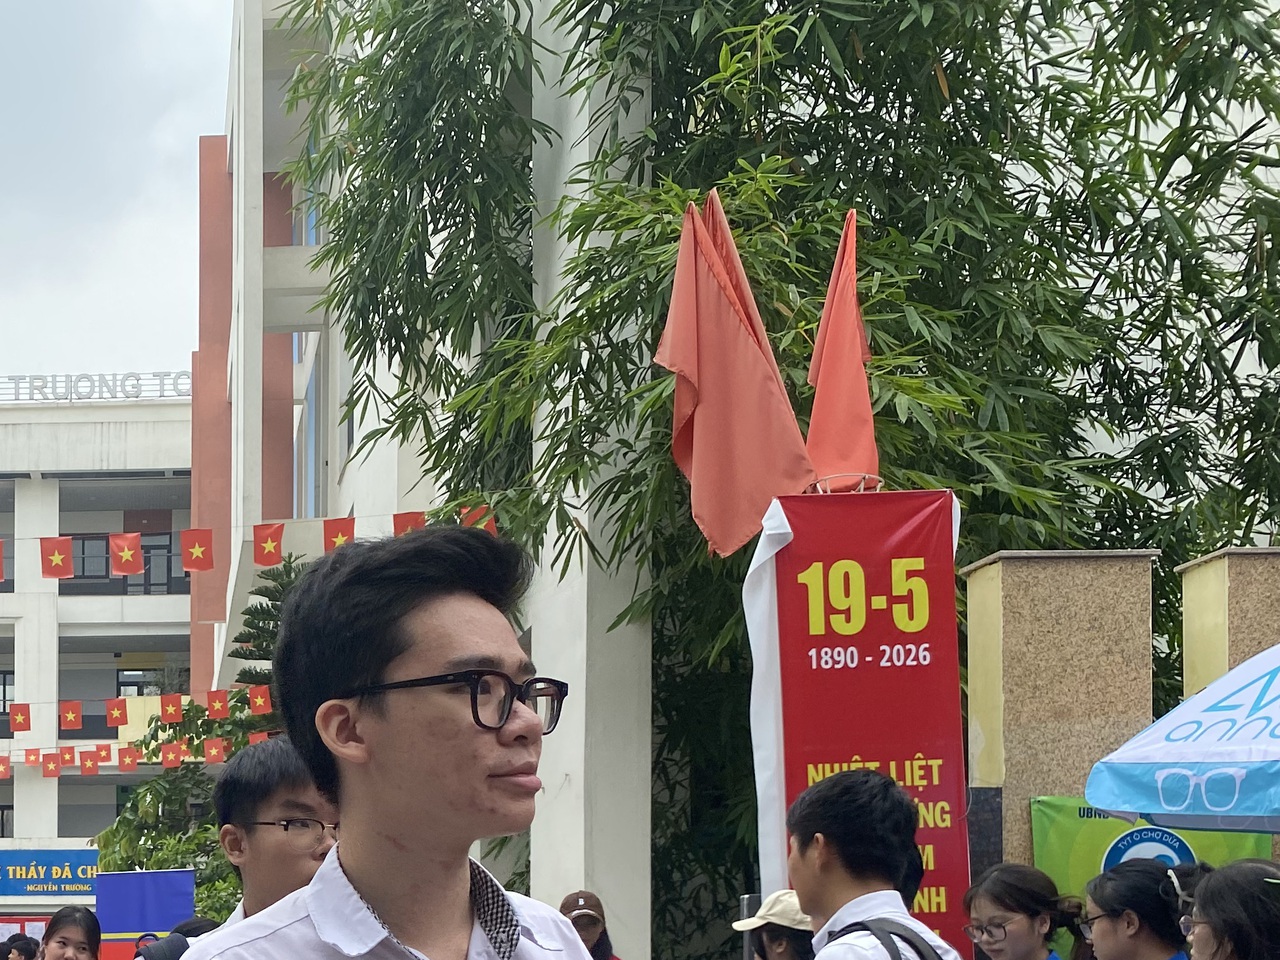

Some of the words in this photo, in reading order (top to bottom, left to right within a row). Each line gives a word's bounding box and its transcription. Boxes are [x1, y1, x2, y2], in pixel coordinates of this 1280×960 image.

[7, 372, 142, 400] TRUONG
[797, 557, 929, 635] 19-5
[808, 646, 859, 669] 1890
[879, 643, 931, 667] 2026
[52, 863, 73, 879] ĐÃ
[77, 865, 99, 879] CH
